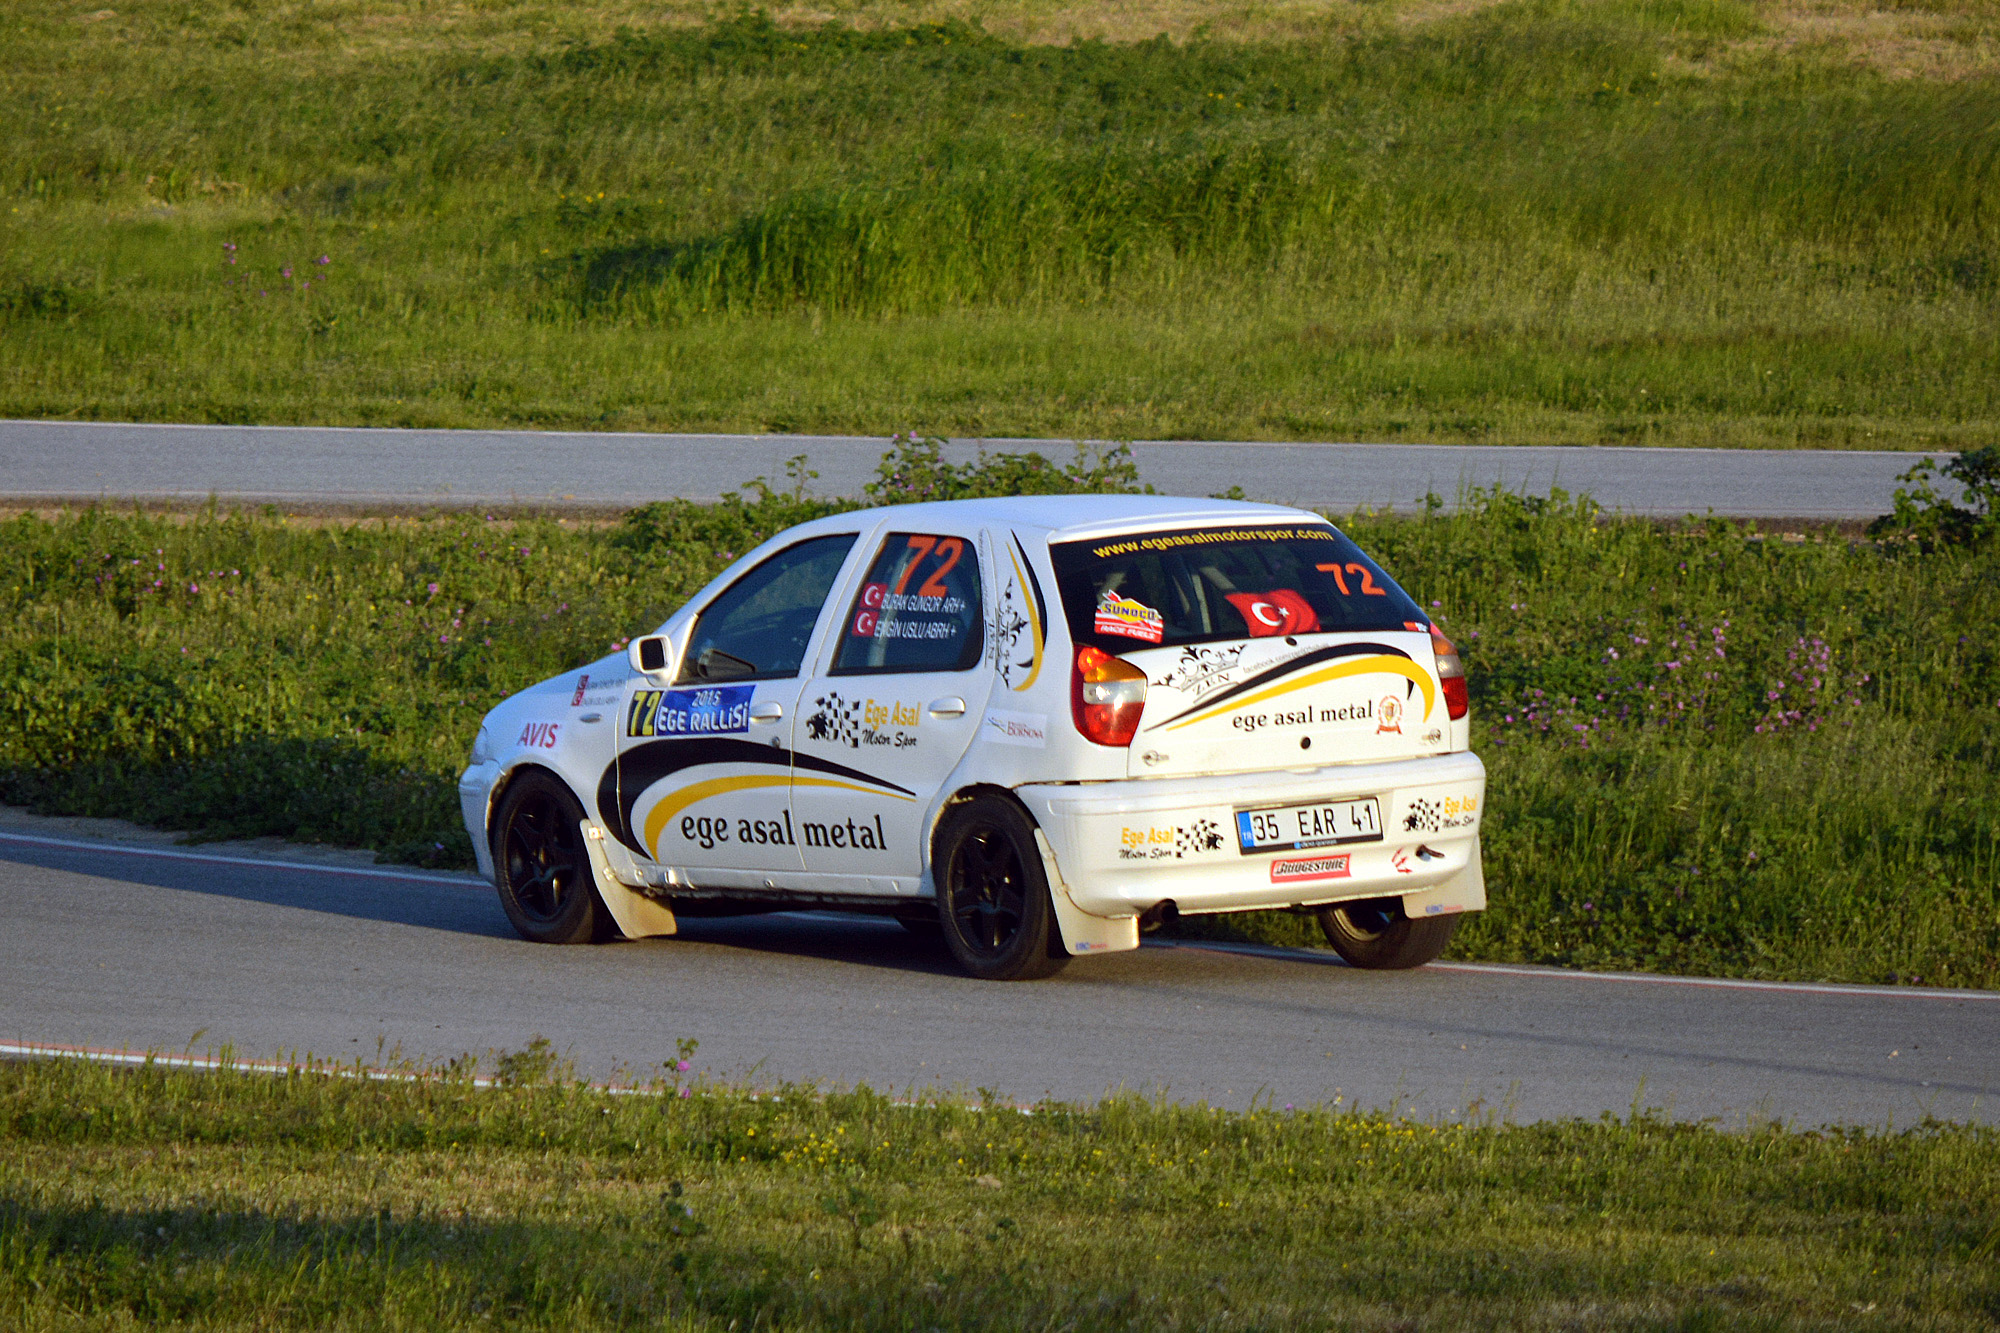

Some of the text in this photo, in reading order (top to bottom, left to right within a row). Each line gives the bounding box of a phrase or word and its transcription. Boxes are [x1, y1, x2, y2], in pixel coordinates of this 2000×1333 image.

[1093, 529, 1334, 558] www.egeasalmotorspor.com
[894, 535, 964, 598] 72
[1315, 563, 1386, 595] 72
[1104, 603, 1155, 620] SUNOCO
[1101, 625, 1126, 634] RACE
[692, 690, 722, 707] 2015
[630, 691, 660, 736] 72
[657, 706, 687, 731] EGE
[864, 698, 921, 731] Ege Asal
[1232, 699, 1373, 732] ege asal metal
[517, 722, 558, 749] AVIS
[862, 729, 918, 749] Motor Spor
[1444, 796, 1460, 818] Ege
[681, 809, 887, 850] ege asal metal
[1253, 804, 1374, 841] 35 EAR 41
[1122, 826, 1174, 849] Ege Asal
[1275, 858, 1345, 875] BRIDGESTONE
